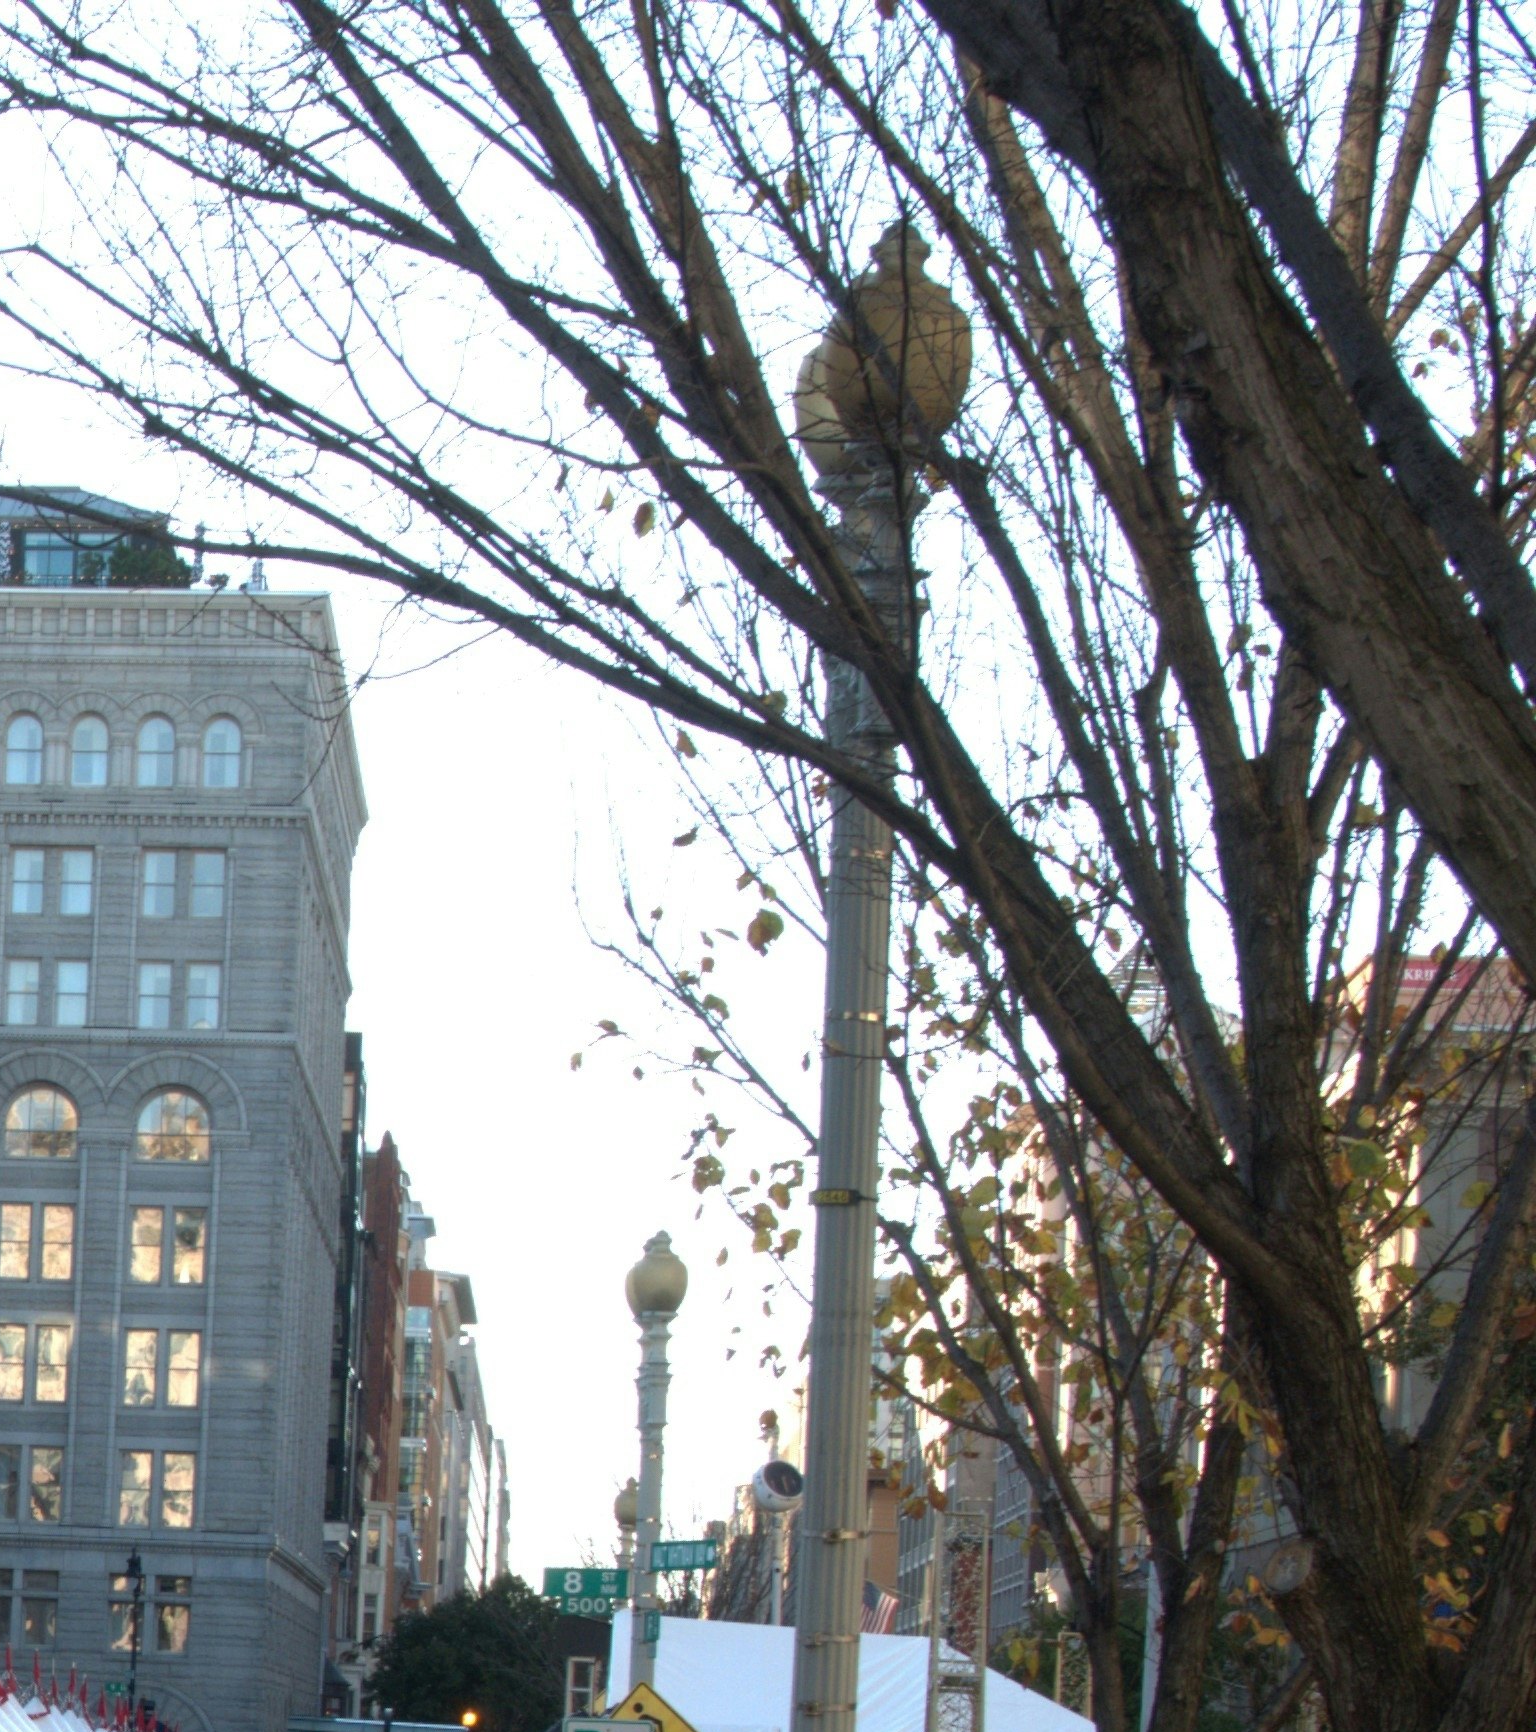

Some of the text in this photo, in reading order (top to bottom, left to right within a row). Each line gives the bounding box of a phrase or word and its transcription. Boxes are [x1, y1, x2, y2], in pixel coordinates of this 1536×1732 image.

[563, 1571, 617, 1594] 8 ST
[600, 1584, 618, 1594] NW
[567, 1598, 607, 1613] 500
